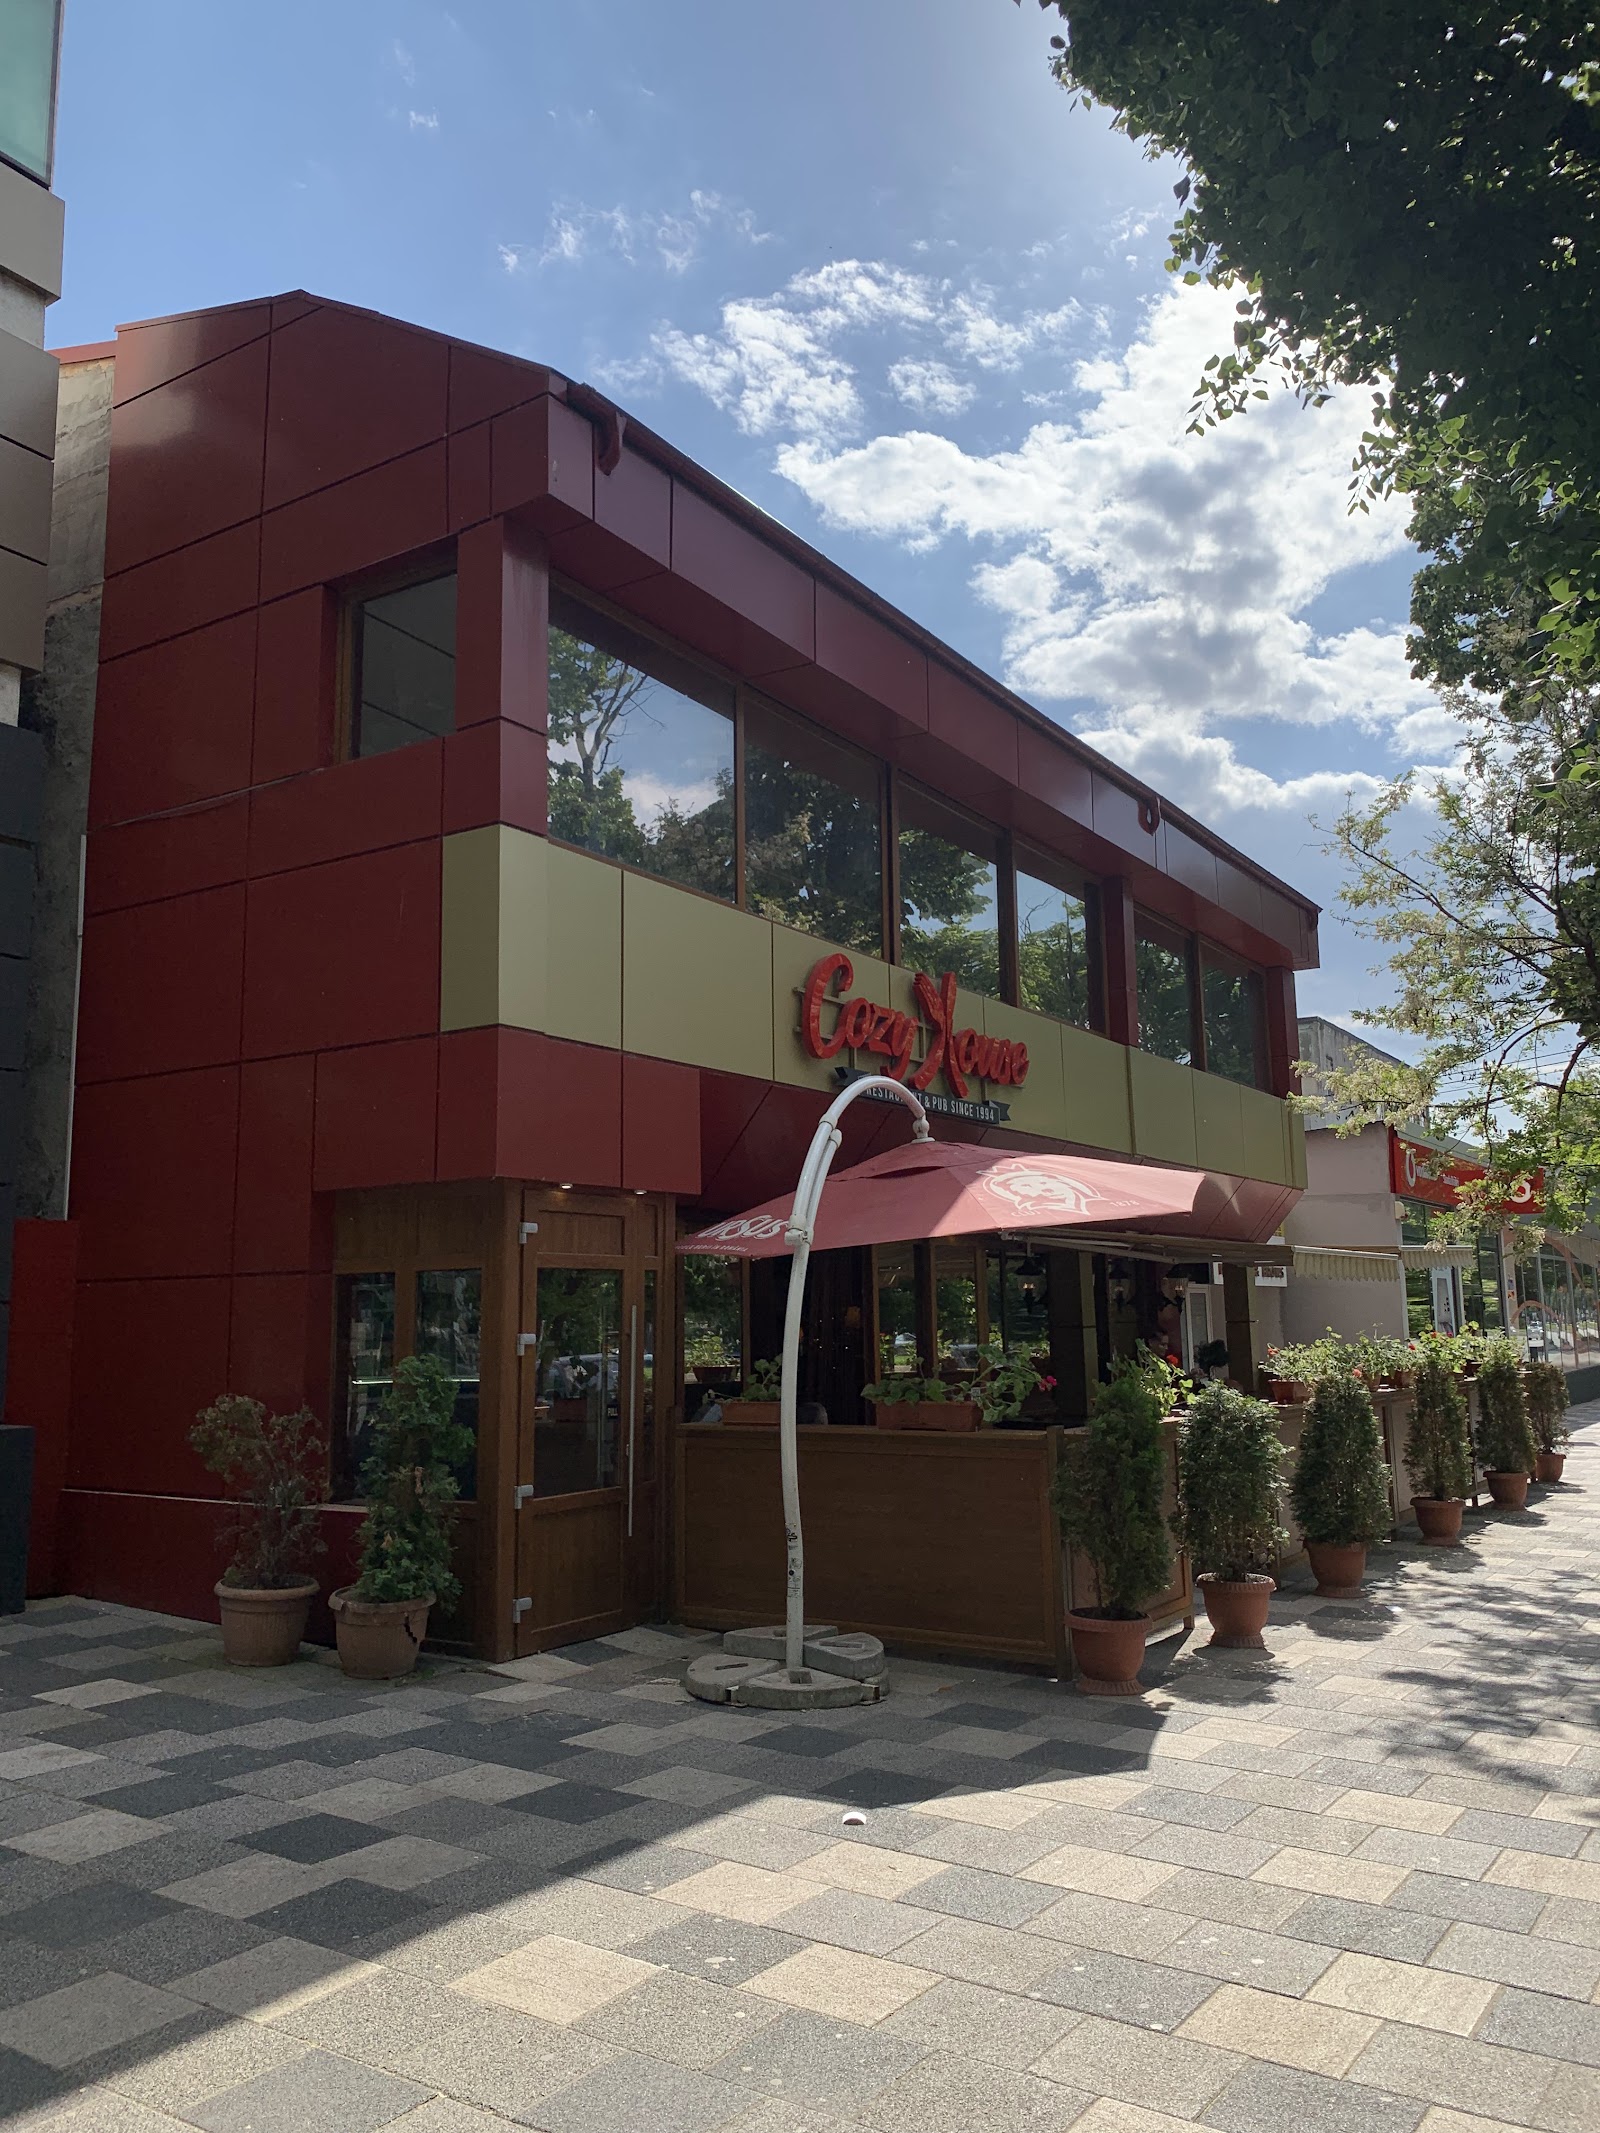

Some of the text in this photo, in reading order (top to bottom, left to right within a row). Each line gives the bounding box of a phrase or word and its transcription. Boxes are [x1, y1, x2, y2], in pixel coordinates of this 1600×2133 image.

[802, 953, 919, 1081] Cozy
[924, 1095, 931, 1108] &
[932, 1097, 948, 1112] PUB
[951, 1100, 973, 1117] SINCE
[975, 1106, 994, 1121] 1994
[1108, 1199, 1140, 1208] 1878
[695, 1214, 789, 1242] URSUS
